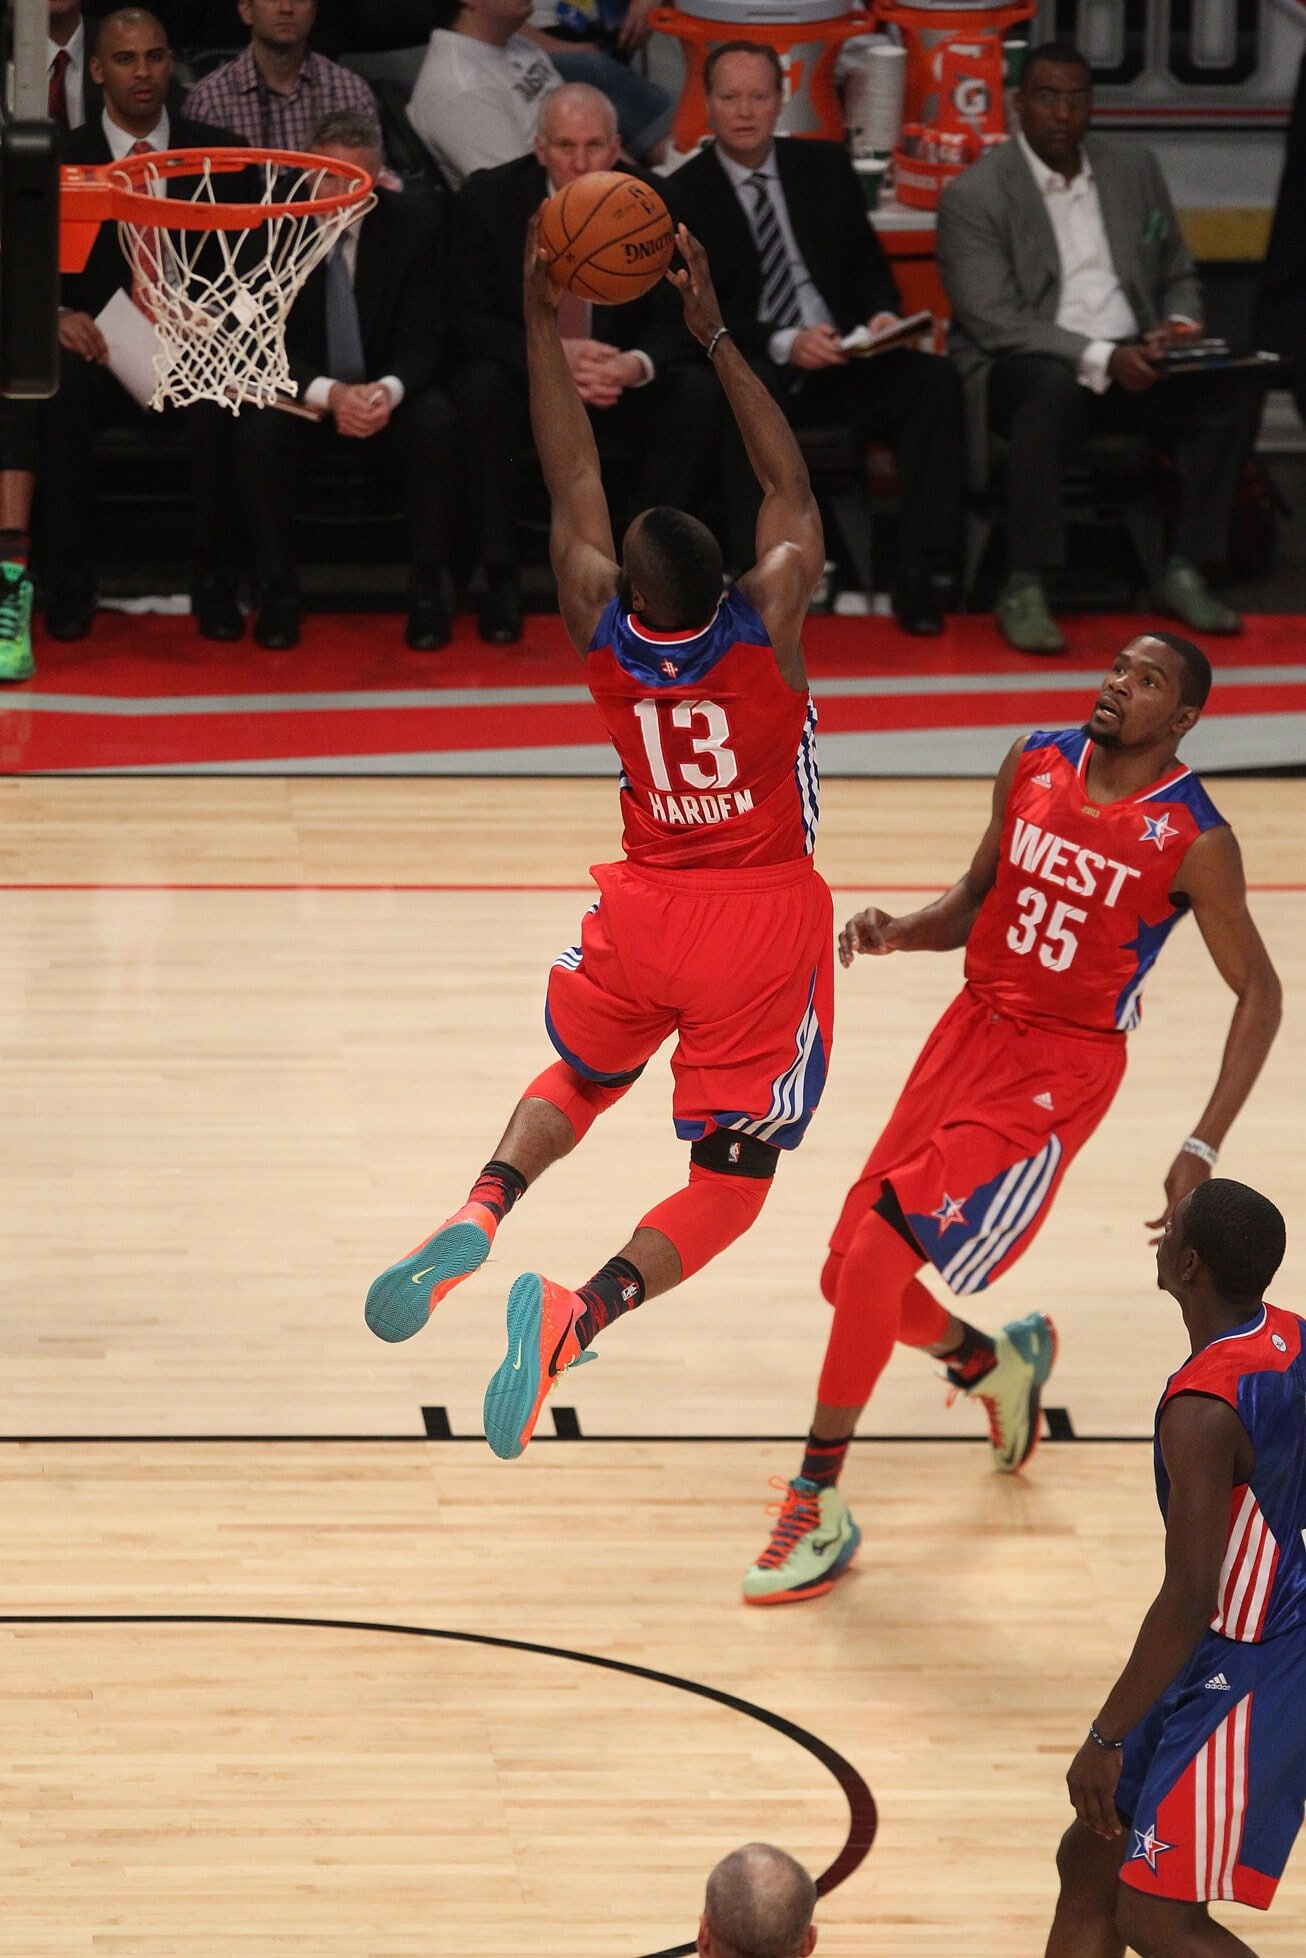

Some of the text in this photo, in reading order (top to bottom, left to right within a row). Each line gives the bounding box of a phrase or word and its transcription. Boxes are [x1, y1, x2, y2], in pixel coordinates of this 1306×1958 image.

[634, 698, 738, 792] 13
[648, 788, 754, 825] HARDEN
[1009, 817, 1142, 908] WEST
[1006, 886, 1088, 972] 35
